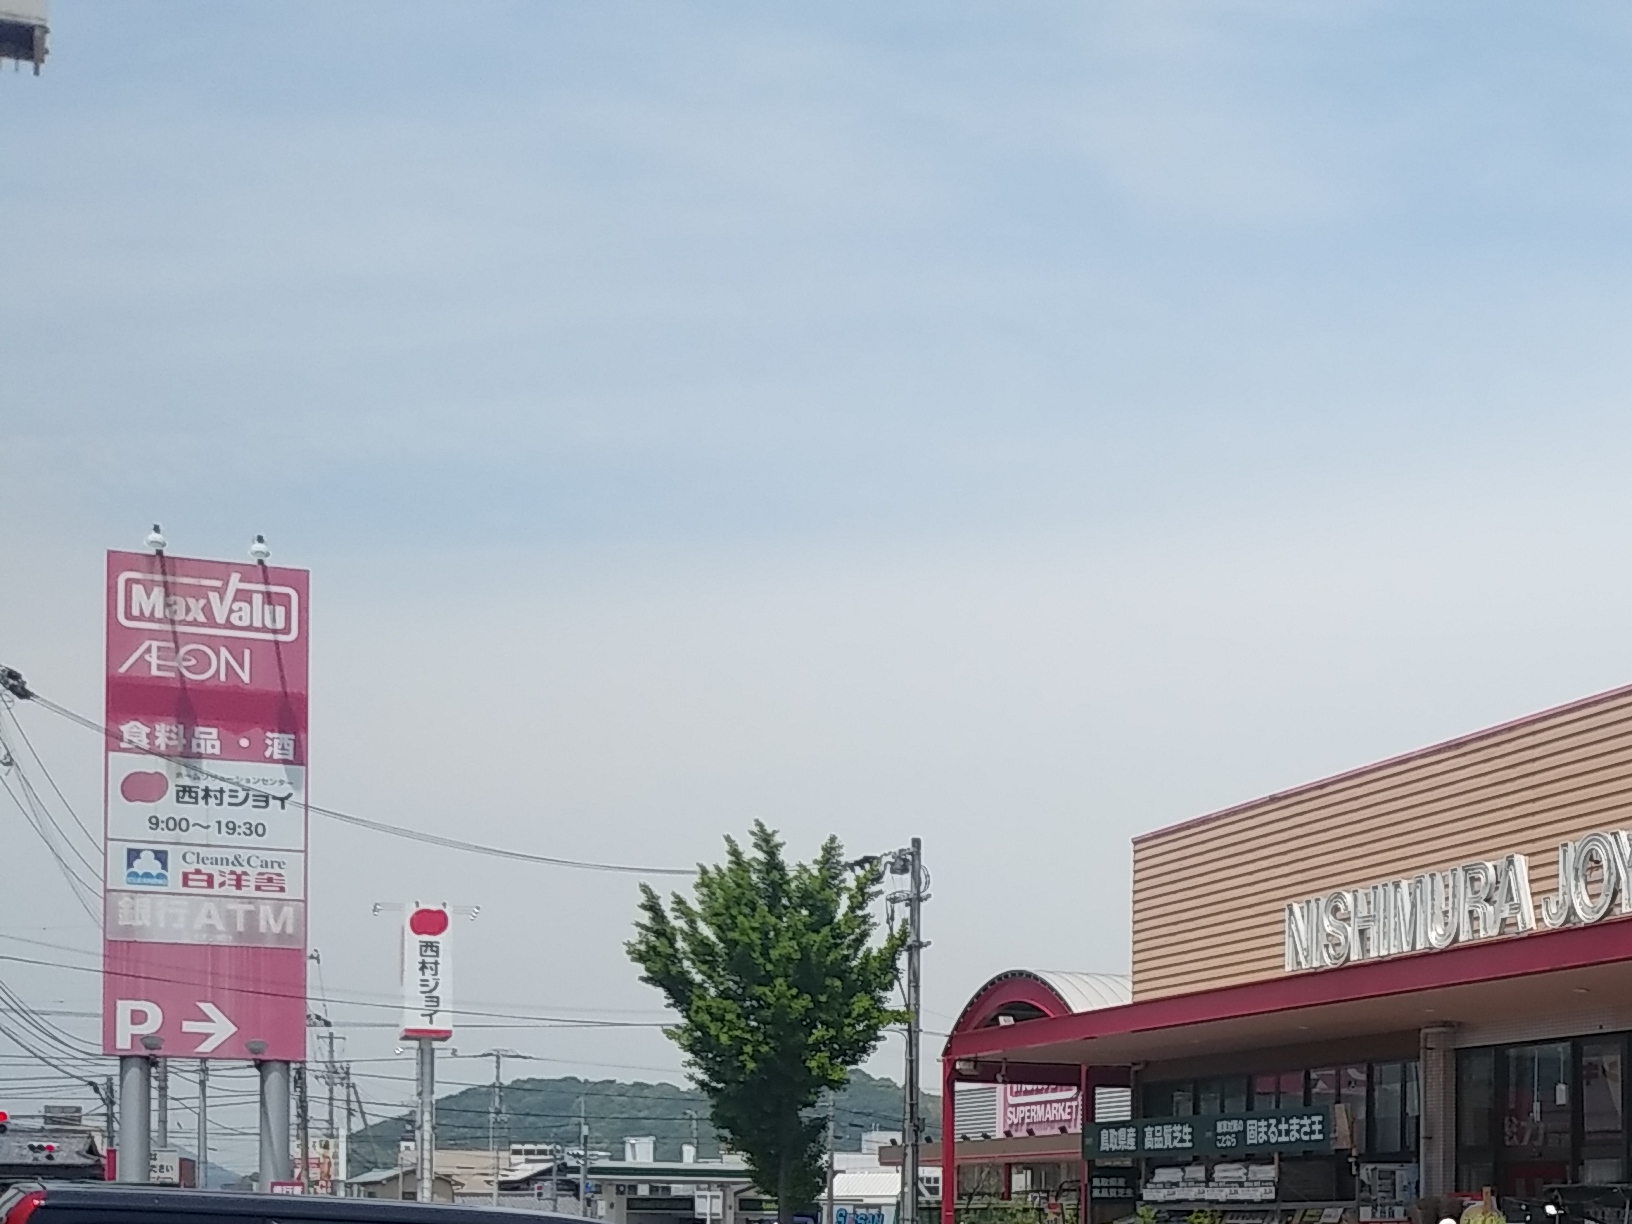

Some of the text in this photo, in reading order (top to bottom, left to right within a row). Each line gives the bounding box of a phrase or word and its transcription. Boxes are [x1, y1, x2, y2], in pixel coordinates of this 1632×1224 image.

[131, 572, 286, 630] MaxValu
[119, 720, 296, 761] 食料品・酒
[175, 784, 294, 810] 西村ジョイ
[182, 851, 287, 870] Clean&Care
[118, 896, 294, 935] 銀行ATM
[1285, 852, 1537, 973] NISHIMURA
[418, 939, 441, 1026] 西村ジョイ
[115, 999, 165, 1050] P
[1006, 1100, 1079, 1125] SUPERMARKET
[1246, 1115, 1324, 1146] 固まる土まさ王
